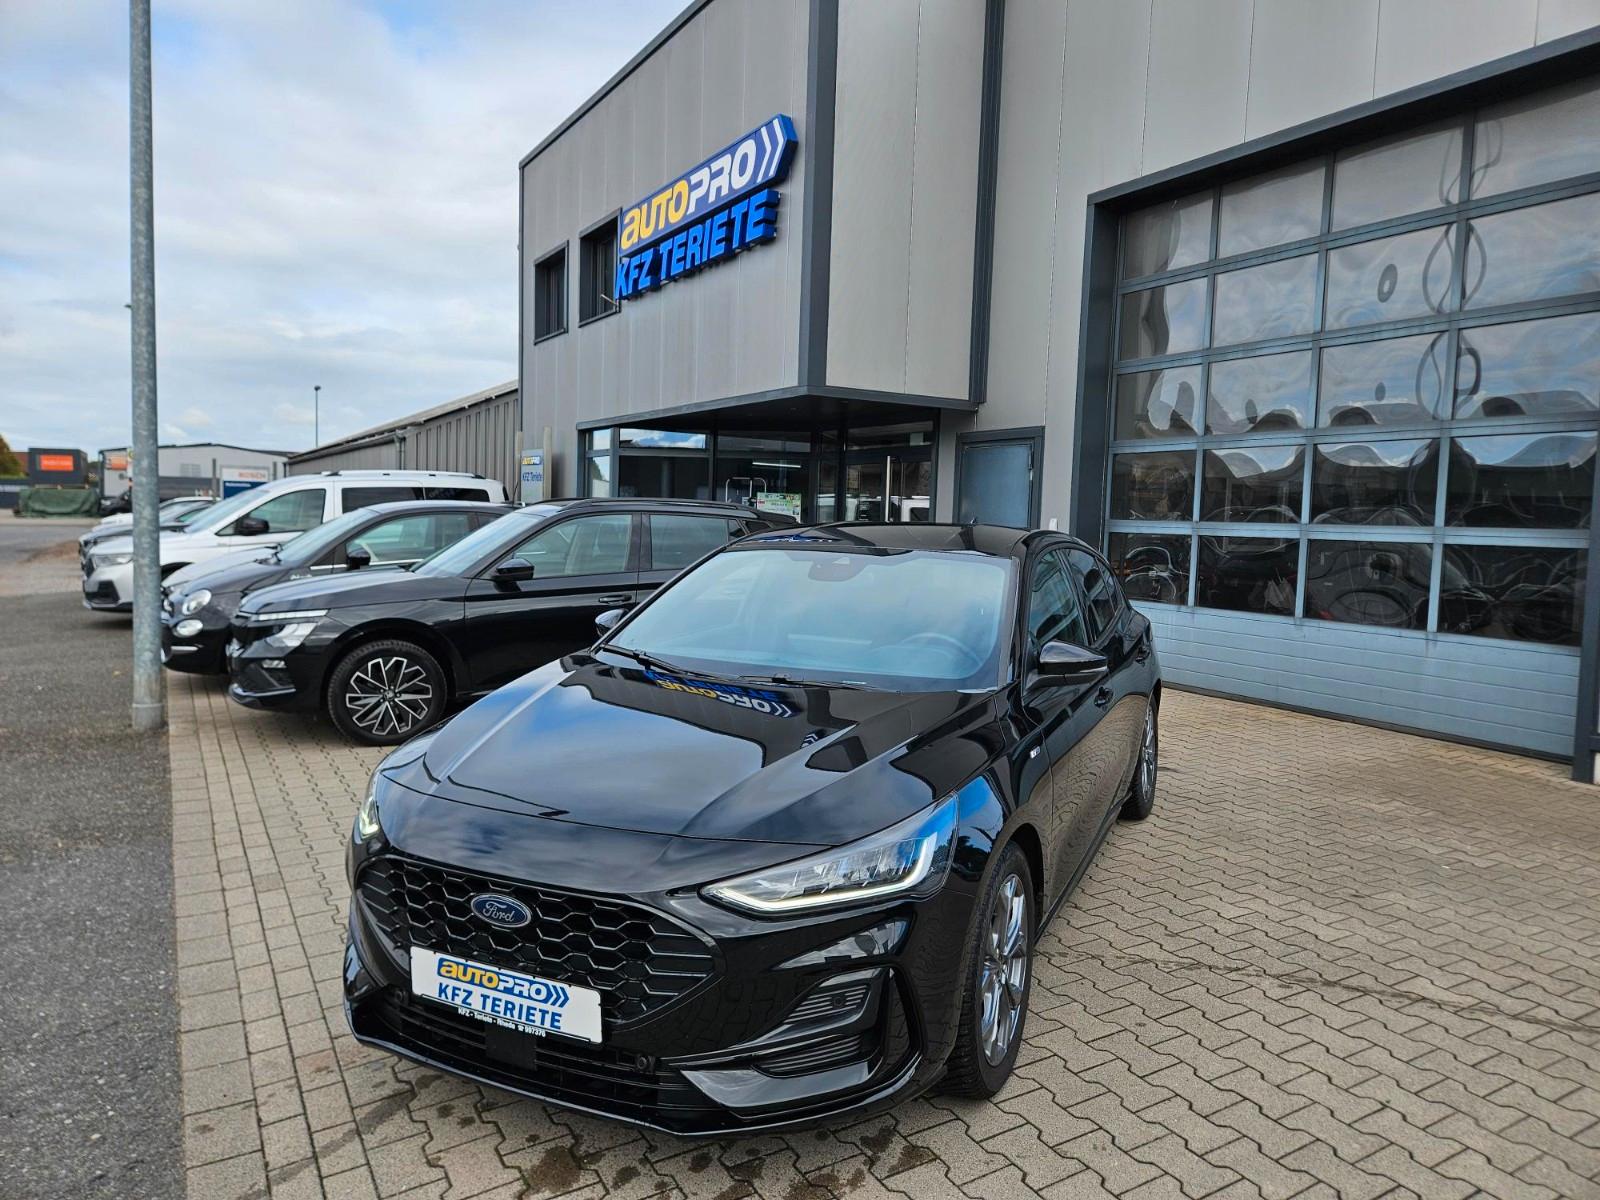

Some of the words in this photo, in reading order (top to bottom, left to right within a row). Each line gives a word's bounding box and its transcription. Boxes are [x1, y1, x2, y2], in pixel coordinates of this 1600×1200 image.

[615, 249, 654, 299] KFZ
[659, 188, 768, 281] TERIETE
[482, 901, 515, 922] Ford
[438, 982, 474, 1007] KFZ
[480, 992, 563, 1030] TERIETE
